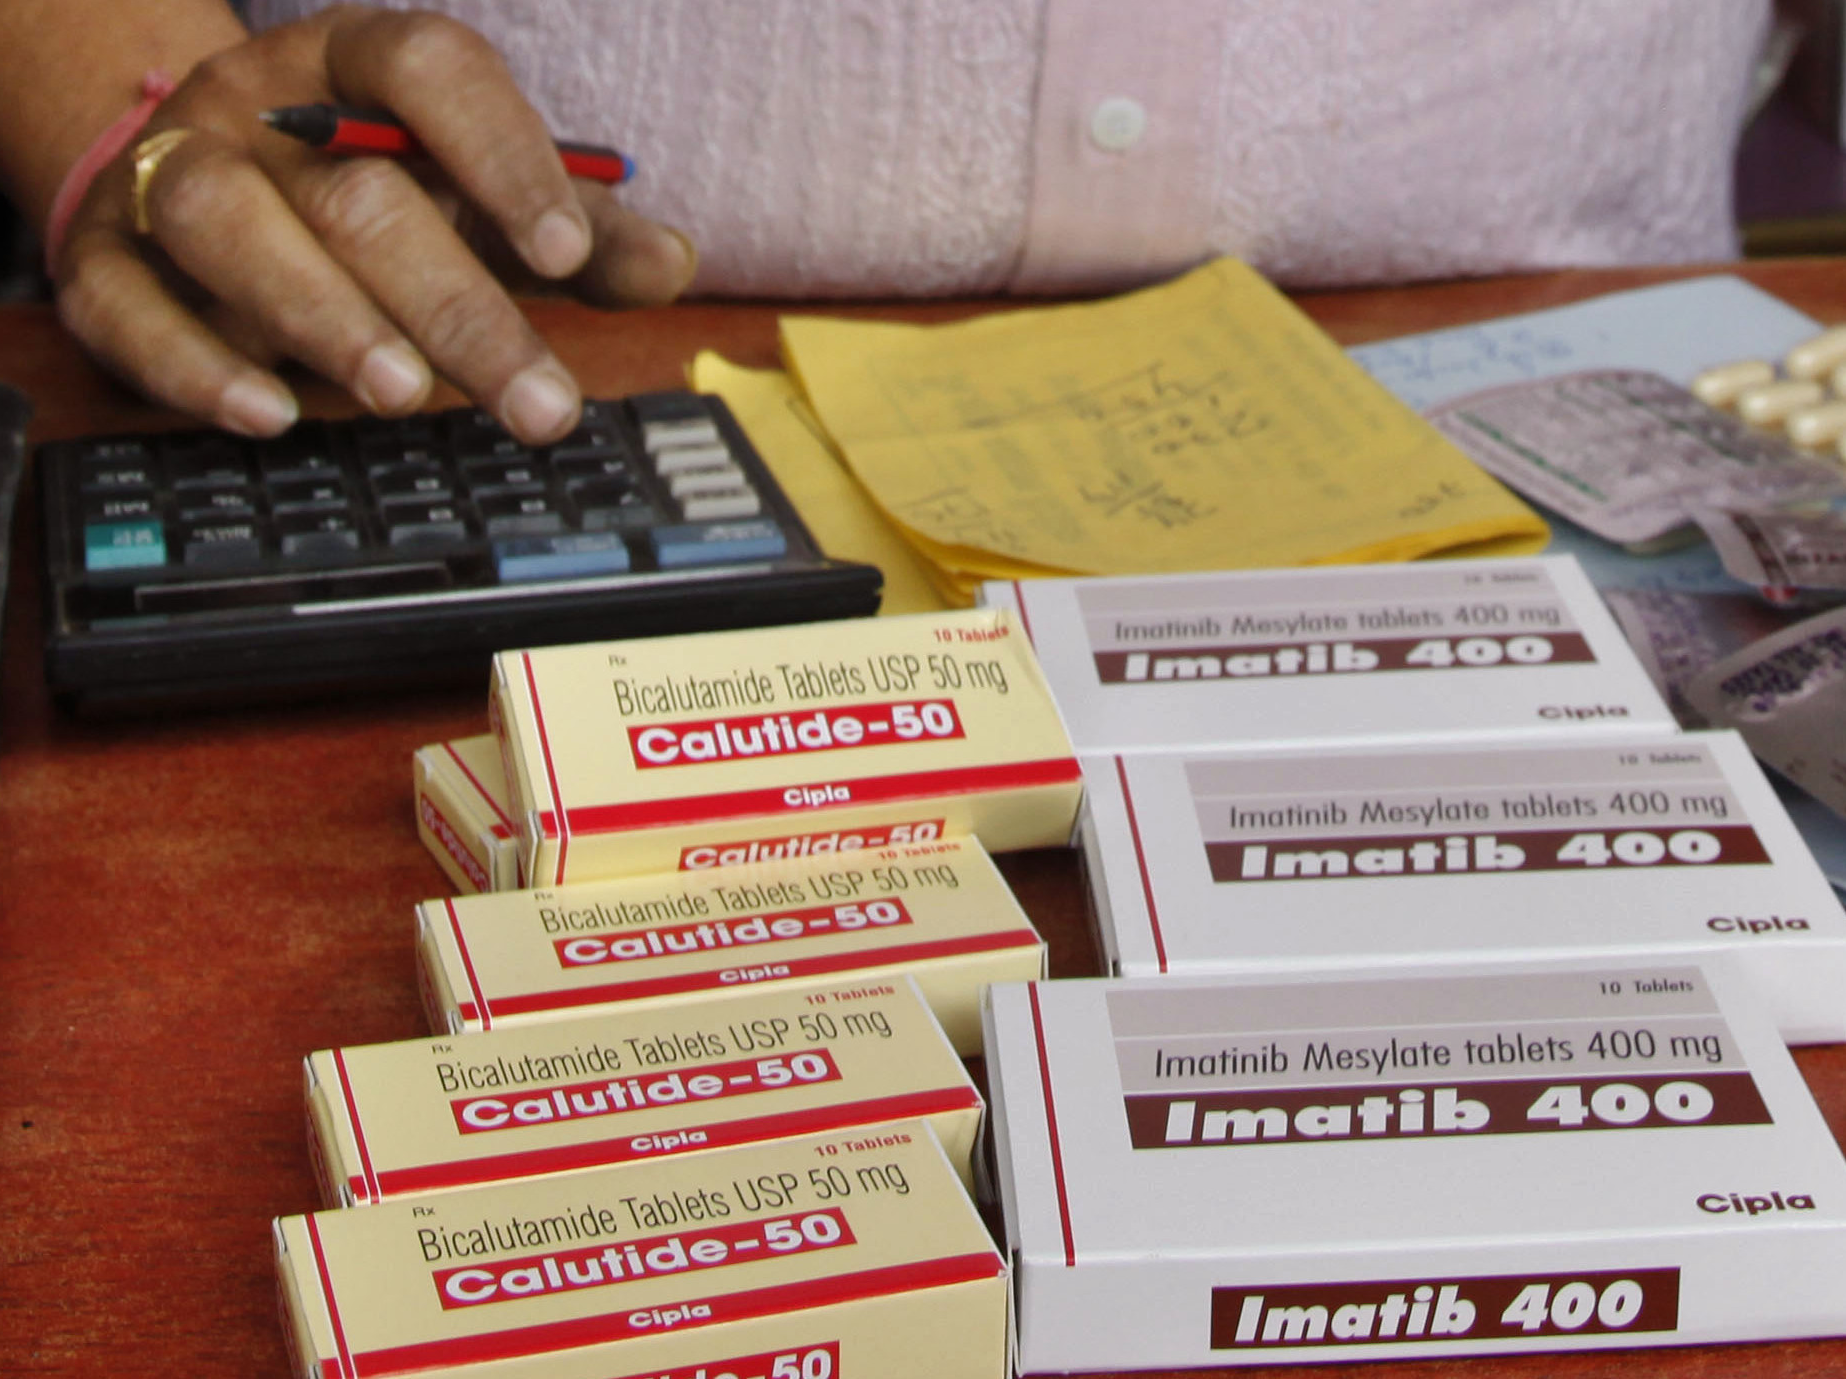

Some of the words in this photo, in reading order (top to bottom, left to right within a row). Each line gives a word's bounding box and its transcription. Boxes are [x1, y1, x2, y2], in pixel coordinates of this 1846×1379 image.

[934, 626, 953, 644] 10
[956, 622, 1010, 644] Tablets
[1116, 619, 1222, 643] Imatinib
[1231, 613, 1351, 642] Mesylate
[1358, 606, 1445, 630] tablets
[1455, 604, 1508, 624] 400
[1519, 605, 1561, 626] mg
[1125, 642, 1381, 681] Imatib
[1406, 636, 1554, 667] 400
[613, 670, 775, 718] Bicalutamide
[775, 656, 867, 704] Tablets
[867, 654, 922, 694] USP
[928, 653, 959, 689] 50
[966, 657, 1010, 695] mg
[1537, 705, 1630, 721] Cipla
[636, 703, 955, 764] Calutide-50
[1620, 755, 1639, 766] 10
[1649, 752, 1703, 765] Tablets
[783, 782, 851, 808] Cipla
[1230, 801, 1348, 830] Imatinib
[1360, 796, 1491, 829] Mesylate
[1501, 791, 1598, 819] tablets
[1609, 790, 1672, 815] 400
[1681, 793, 1729, 818] mg
[1241, 835, 1527, 879] Imatib
[1557, 830, 1722, 868] 400
[539, 890, 710, 935] Bicalutamide
[711, 875, 805, 918] Tablets
[808, 870, 865, 900] USP
[872, 865, 908, 891] 50
[913, 863, 959, 889] mg
[563, 900, 901, 965] Calutide-50
[1707, 916, 1811, 936] Cipla
[719, 961, 791, 984] Cipla
[1599, 980, 1622, 994] 10
[1633, 977, 1696, 993] Tablets
[804, 992, 824, 1007] 10
[829, 982, 896, 1004] Tablets
[435, 1043, 621, 1093] Bicalutamide
[624, 1028, 727, 1069] Tablets
[731, 1018, 791, 1053] USP
[797, 1013, 840, 1043] 50
[844, 1006, 894, 1040] mg
[1155, 1044, 1289, 1078] Imatinib
[1304, 1038, 1452, 1075] Mesylate
[1463, 1031, 1573, 1066] tablets
[1587, 1028, 1657, 1060] 400
[1670, 1031, 1723, 1065] mg
[461, 1052, 830, 1129] Calutide-50
[1164, 1087, 1492, 1143] Imatib
[1526, 1081, 1715, 1126] 400
[630, 1127, 709, 1154] Cipla
[813, 1143, 839, 1159] 10
[844, 1130, 913, 1155] Tablets
[417, 1205, 618, 1263] Bicalutamide
[618, 1185, 733, 1233] Tablets
[733, 1174, 801, 1213] USP
[808, 1167, 853, 1200] 50
[856, 1157, 912, 1199] mg
[1696, 1190, 1817, 1214] Cipla
[445, 1212, 844, 1303] Calutide-50
[627, 1301, 713, 1329] Cipla
[1234, 1287, 1477, 1343] Imatib
[1500, 1278, 1645, 1332] 400
